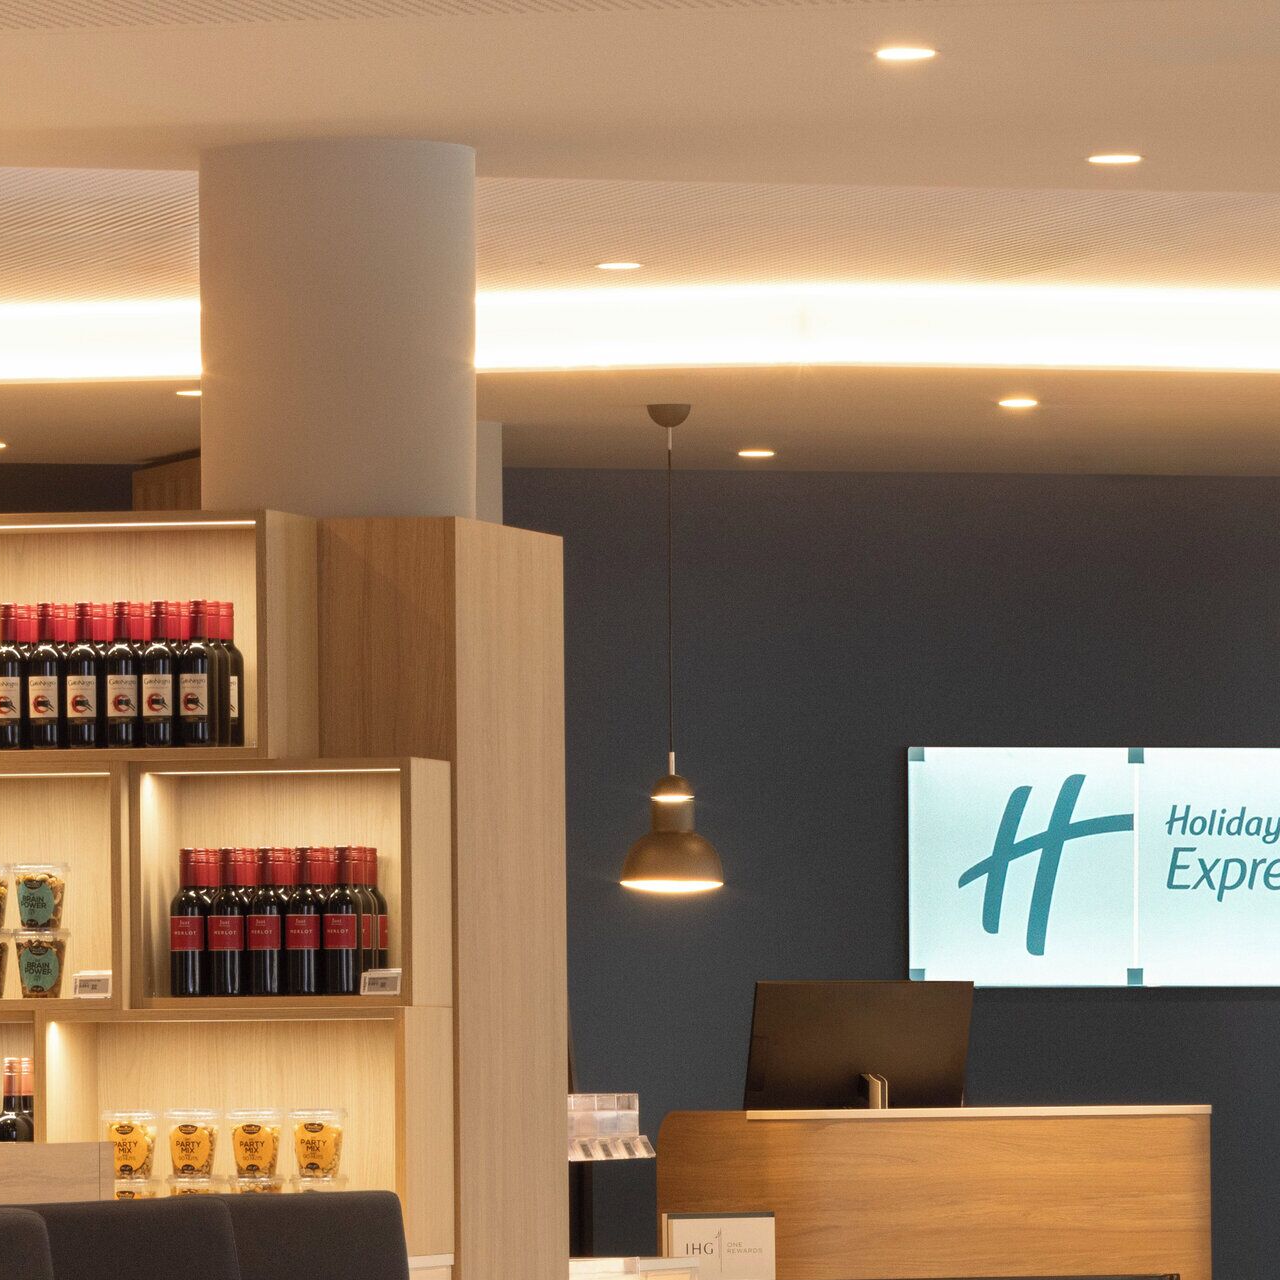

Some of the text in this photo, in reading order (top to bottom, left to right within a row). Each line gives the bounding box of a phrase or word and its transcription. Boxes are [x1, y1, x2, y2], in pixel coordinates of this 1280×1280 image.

[22, 894, 44, 902] BRAIN
[20, 901, 47, 909] POWER
[26, 961, 50, 969] BRAIN
[24, 968, 52, 976] POWER
[239, 1140, 265, 1148] PARTY
[685, 1242, 714, 1255] IHG
